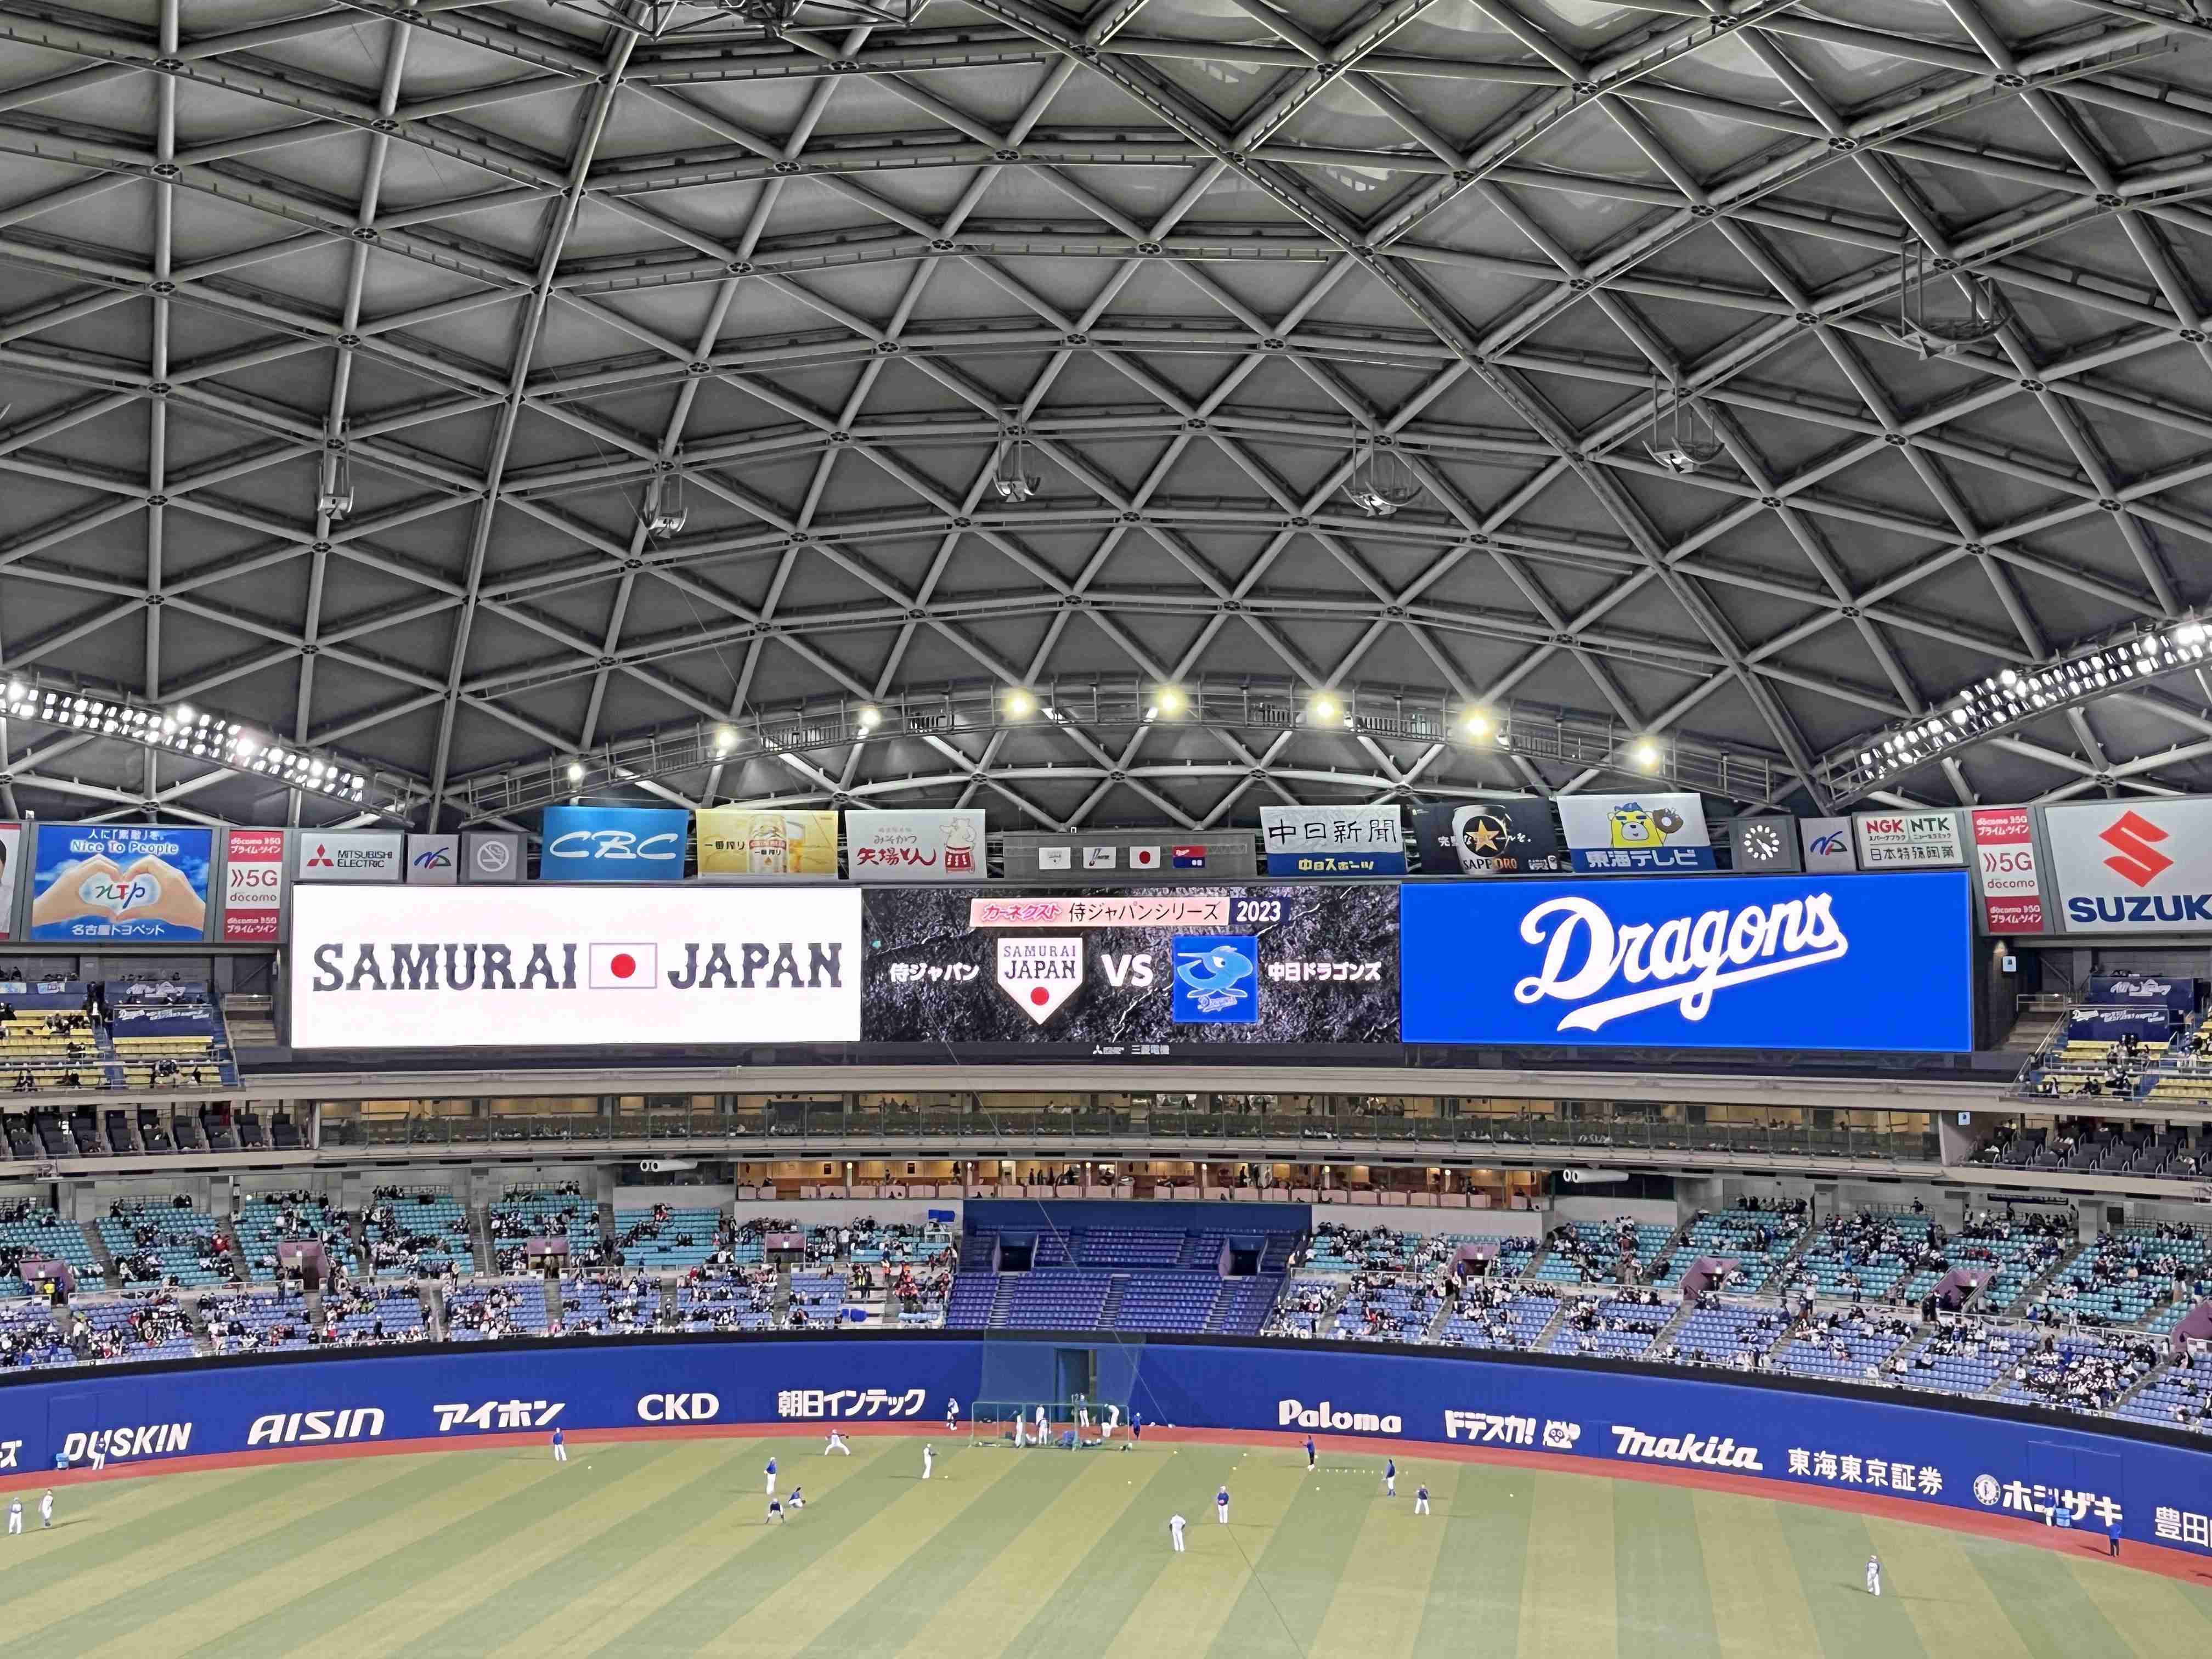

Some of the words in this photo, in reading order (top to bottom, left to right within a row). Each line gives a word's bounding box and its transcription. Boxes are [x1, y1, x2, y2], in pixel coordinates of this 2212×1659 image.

[1268, 819, 1397, 844] 中日新聞
[1866, 819, 1904, 833] NGK
[1910, 817, 1950, 832] NTK
[71, 840, 104, 853] Nice
[109, 840, 125, 853] To
[129, 841, 179, 854] People
[549, 831, 678, 859] CBC
[874, 835, 917, 844] みそかつ
[337, 850, 392, 859] MITSUBISHI
[337, 859, 384, 867] ELECTRIC
[856, 847, 936, 866] 矢場とん
[1299, 859, 1374, 871] 中日スポーツ
[1463, 858, 1518, 870] SAPPORO
[1585, 849, 1699, 868] 東海テレビ
[1988, 879, 2035, 888] docomo
[230, 893, 277, 901] docomo
[982, 902, 1062, 922] カーネクスト
[1069, 902, 1221, 922] 侍ジャパンシリーズ
[1236, 901, 1281, 922] 2023
[1003, 945, 1076, 957] SAMURAI
[313, 942, 577, 991] SAMURAI
[668, 942, 842, 989] JAPAN
[890, 962, 980, 983] 侍ジャパン
[1005, 961, 1075, 979] JAPAN
[1101, 954, 1154, 987] VS
[1268, 961, 1381, 982] 中日ドラゴンズ
[1514, 893, 1849, 1032] Dragons
[637, 1393, 719, 1420] CKD
[778, 1389, 925, 1417] 朝日インテック
[433, 1400, 566, 1431] アイホン
[1279, 1400, 1401, 1433] Paloma
[247, 1408, 385, 1445] AISIN
[63, 1423, 192, 1460] DUSKIN
[1787, 1448, 1943, 1496] 東海東京証券
[2002, 1481, 2123, 1527] ホシザキ
[2155, 1506, 2212, 1548] 豊田
